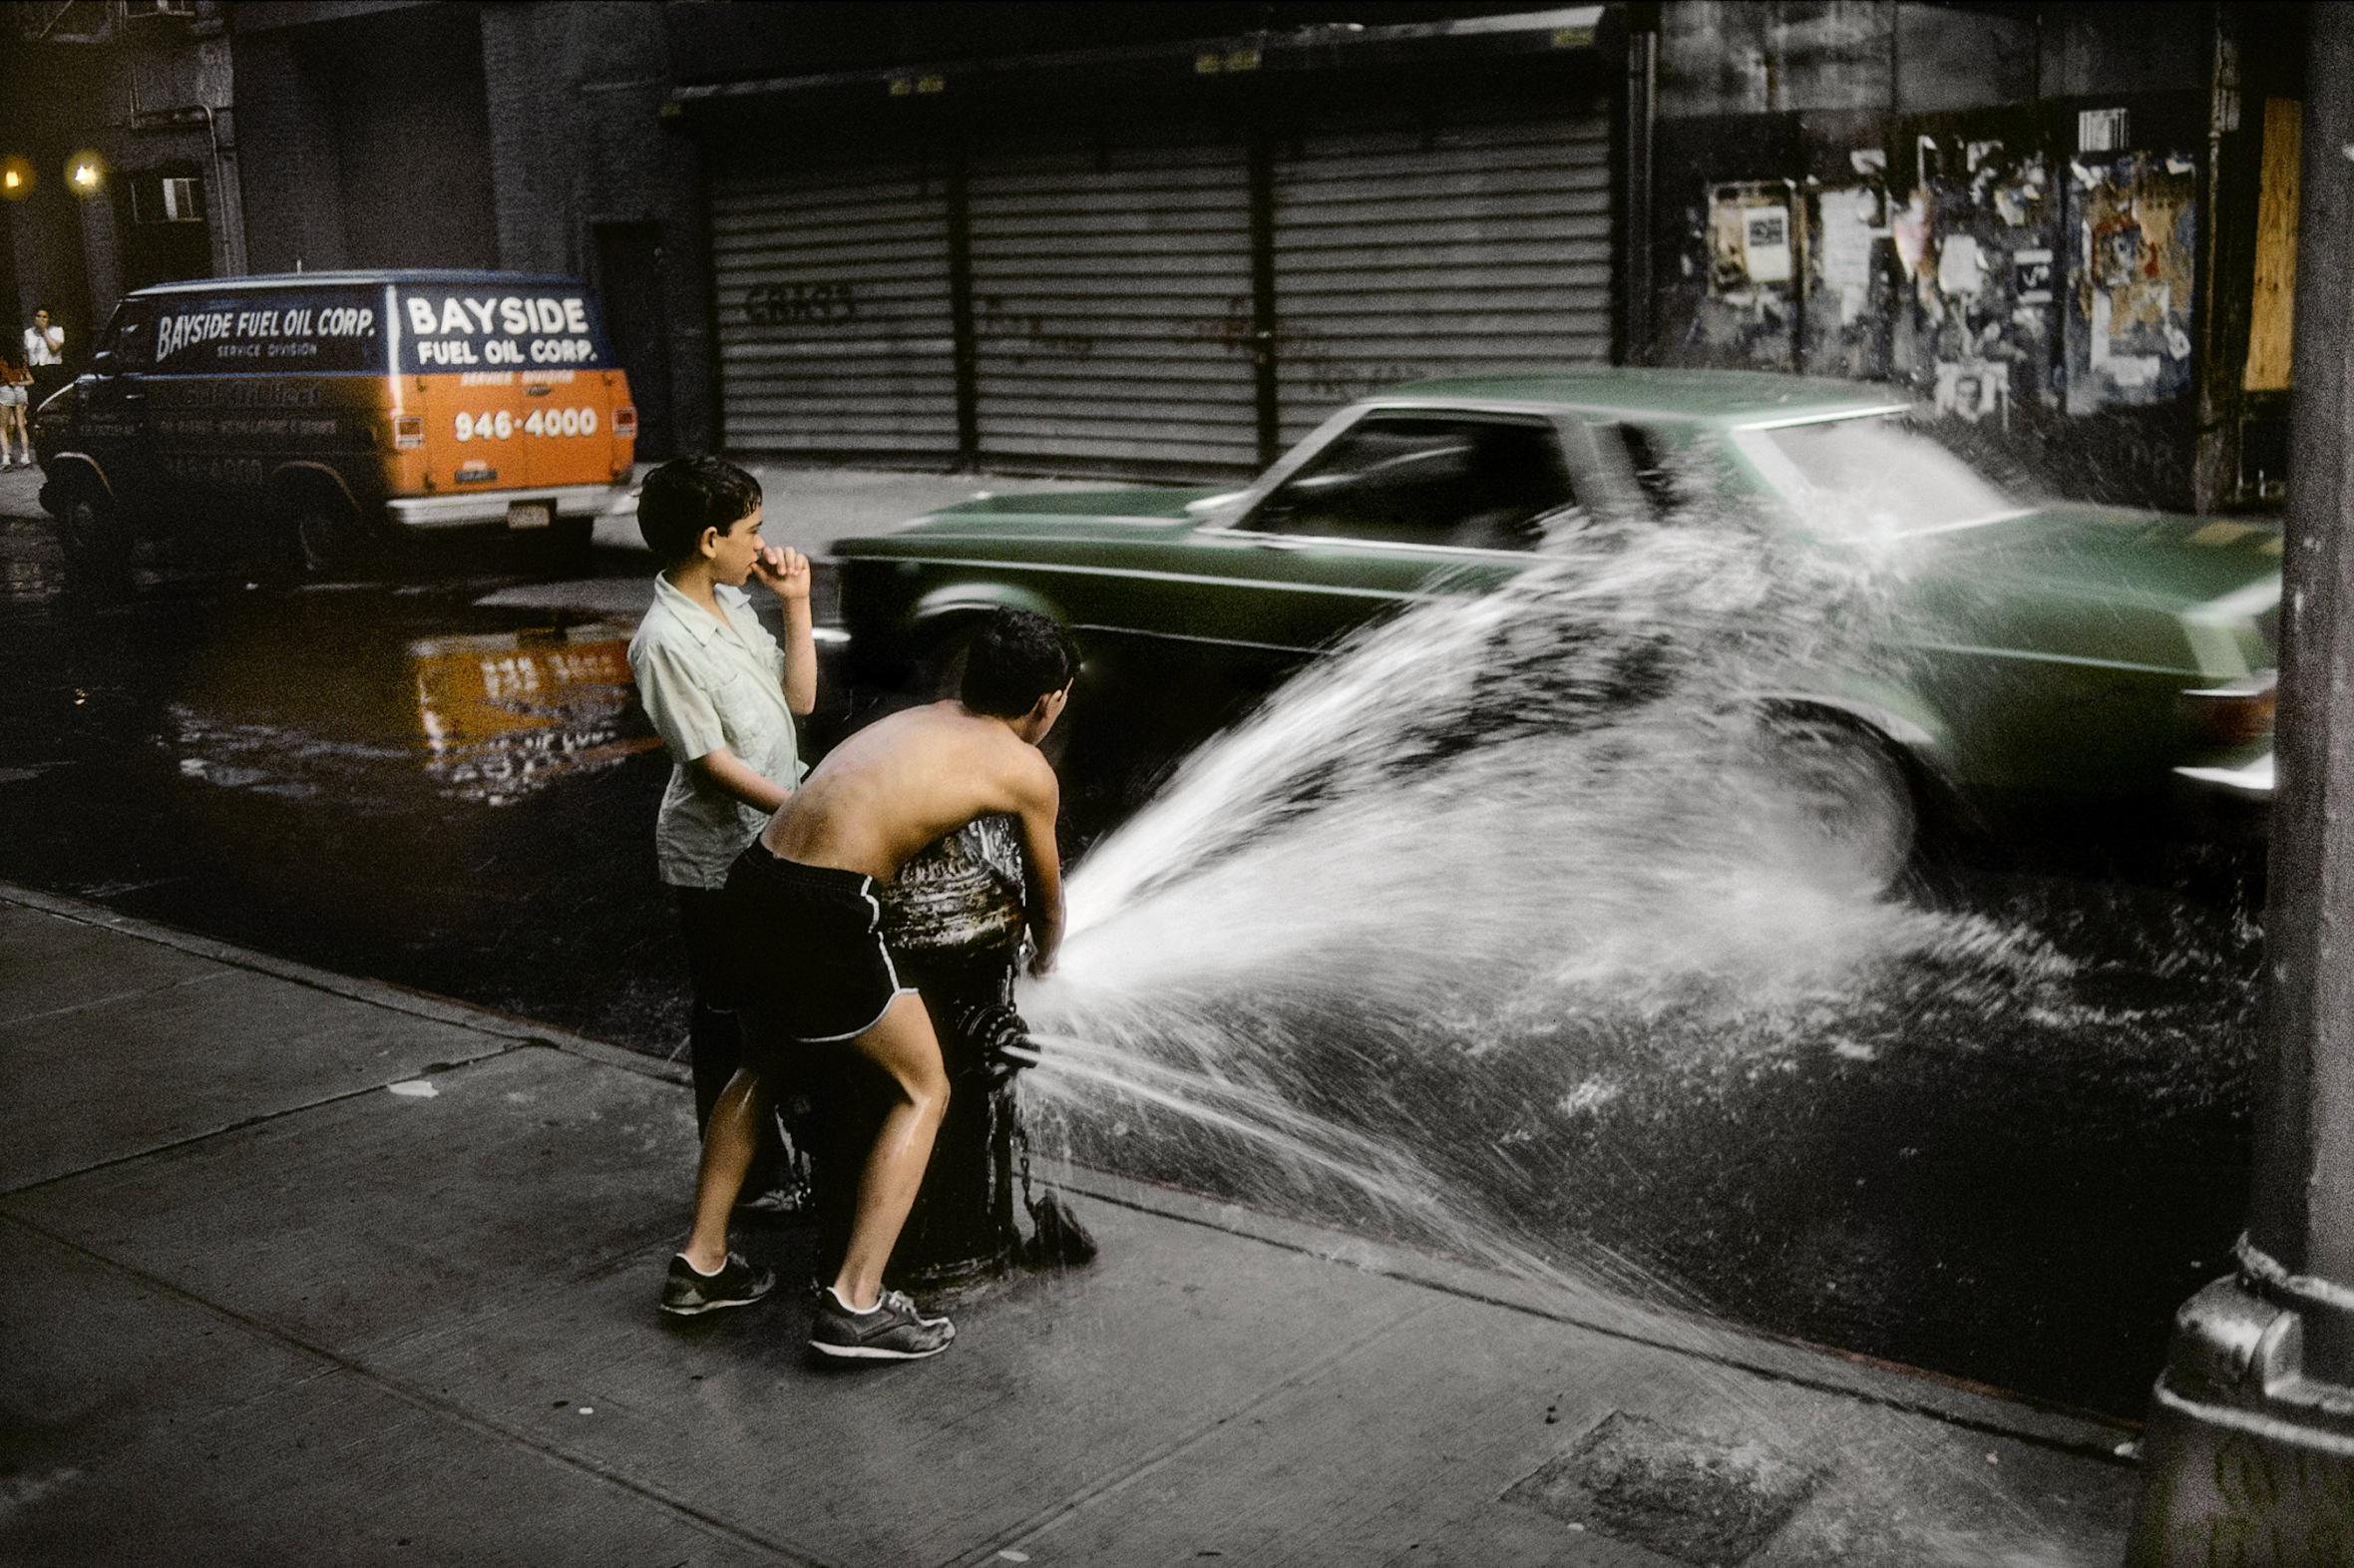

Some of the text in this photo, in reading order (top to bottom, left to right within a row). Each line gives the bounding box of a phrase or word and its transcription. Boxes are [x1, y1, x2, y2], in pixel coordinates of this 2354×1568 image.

[407, 297, 588, 334] BAYSIDE
[156, 307, 376, 363] BAYSIDE FUEL OIL CORP.
[216, 342, 317, 358] SERVICE DIVISION
[418, 339, 598, 365] FUEL OIL CORP.
